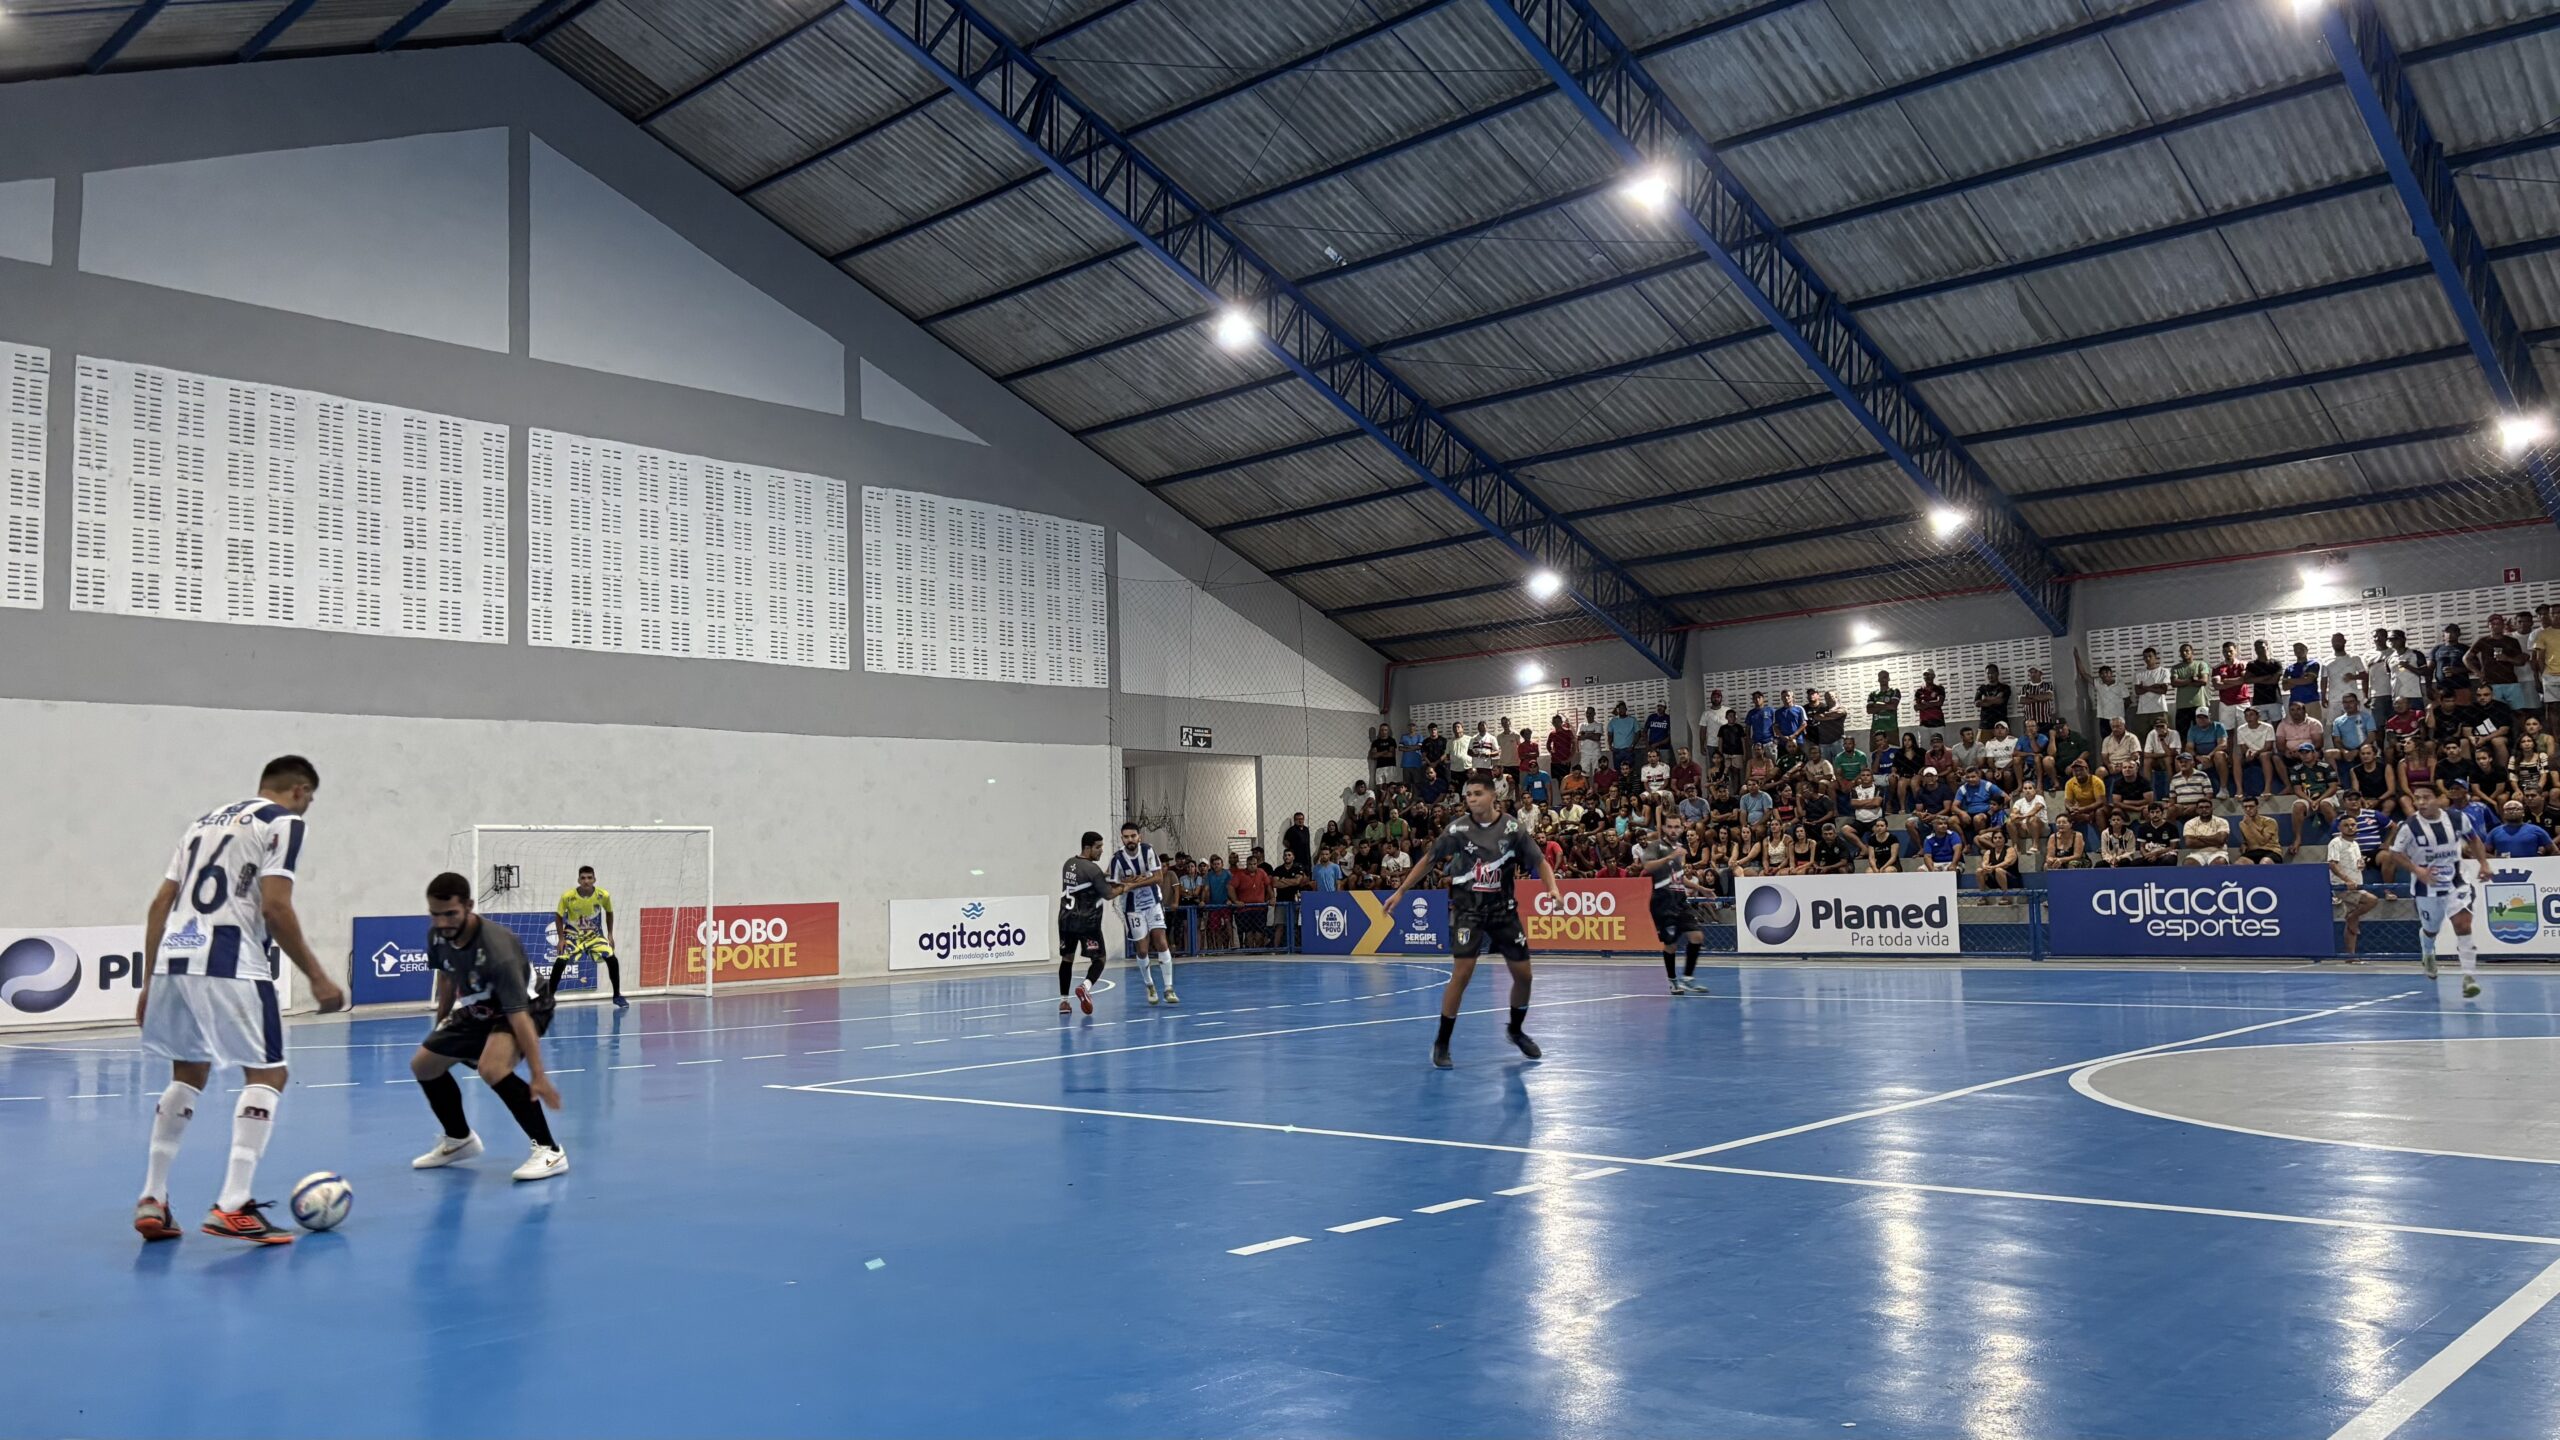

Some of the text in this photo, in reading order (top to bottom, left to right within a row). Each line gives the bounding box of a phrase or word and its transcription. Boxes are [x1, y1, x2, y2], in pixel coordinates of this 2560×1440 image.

[173, 834, 234, 915] 16
[1065, 885, 1076, 910] 5
[1534, 891, 1616, 915] GLOBO
[1131, 918, 1141, 928] 13
[1811, 896, 1948, 929] Plamed
[697, 917, 788, 945] GLOBO
[1404, 933, 1437, 941] SERGIPE
[1527, 916, 1626, 940] ESPORTE
[1851, 931, 1949, 946] Pra toda vida
[2147, 915, 2280, 941] esportes
[2543, 929, 2560, 937] PE
[919, 922, 1026, 959] agitação
[400, 953, 429, 962] CASA
[400, 963, 430, 972] SERGI
[687, 942, 797, 972] ESPORTE
